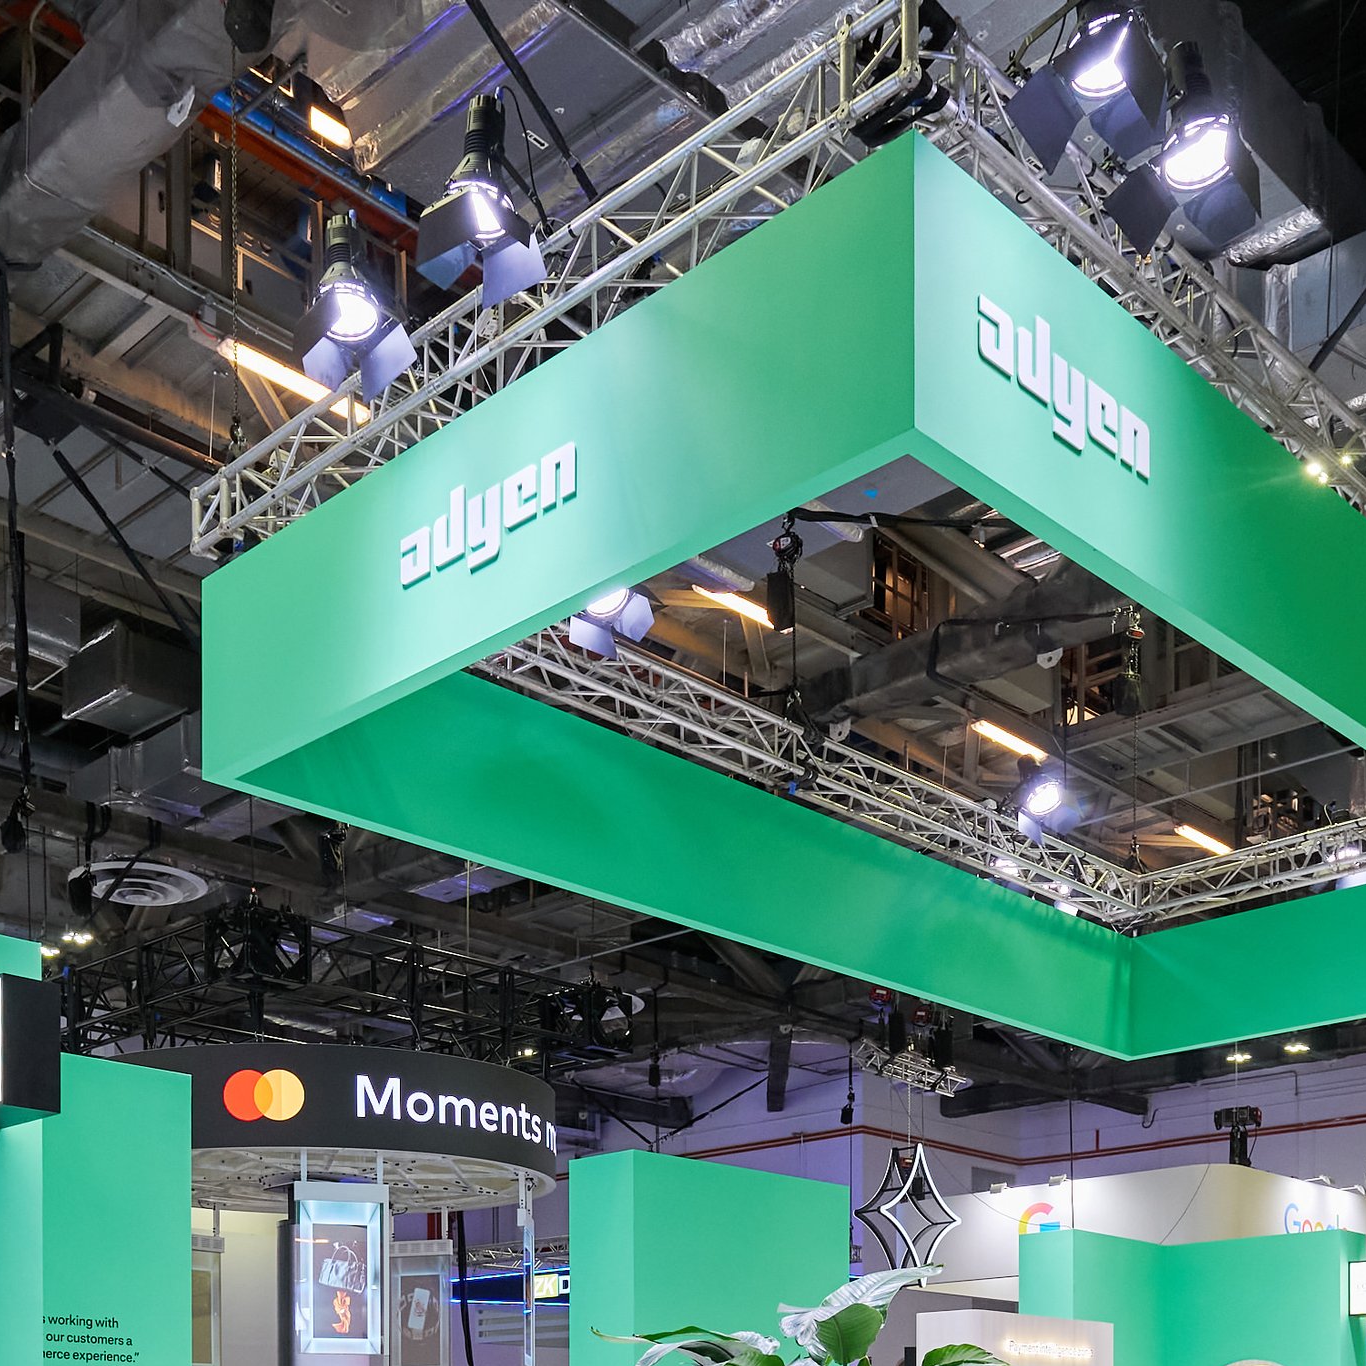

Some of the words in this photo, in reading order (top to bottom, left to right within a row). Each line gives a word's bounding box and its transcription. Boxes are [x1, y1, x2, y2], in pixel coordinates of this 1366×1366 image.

[978, 293, 1150, 483] adyen
[400, 440, 577, 588] adyen
[356, 1074, 541, 1144] Moments
[45, 1333, 64, 1342] our
[66, 1334, 124, 1346] customers
[126, 1338, 133, 1346] a
[48, 1314, 93, 1329] working
[95, 1317, 119, 1328] with
[43, 1350, 70, 1359] erce
